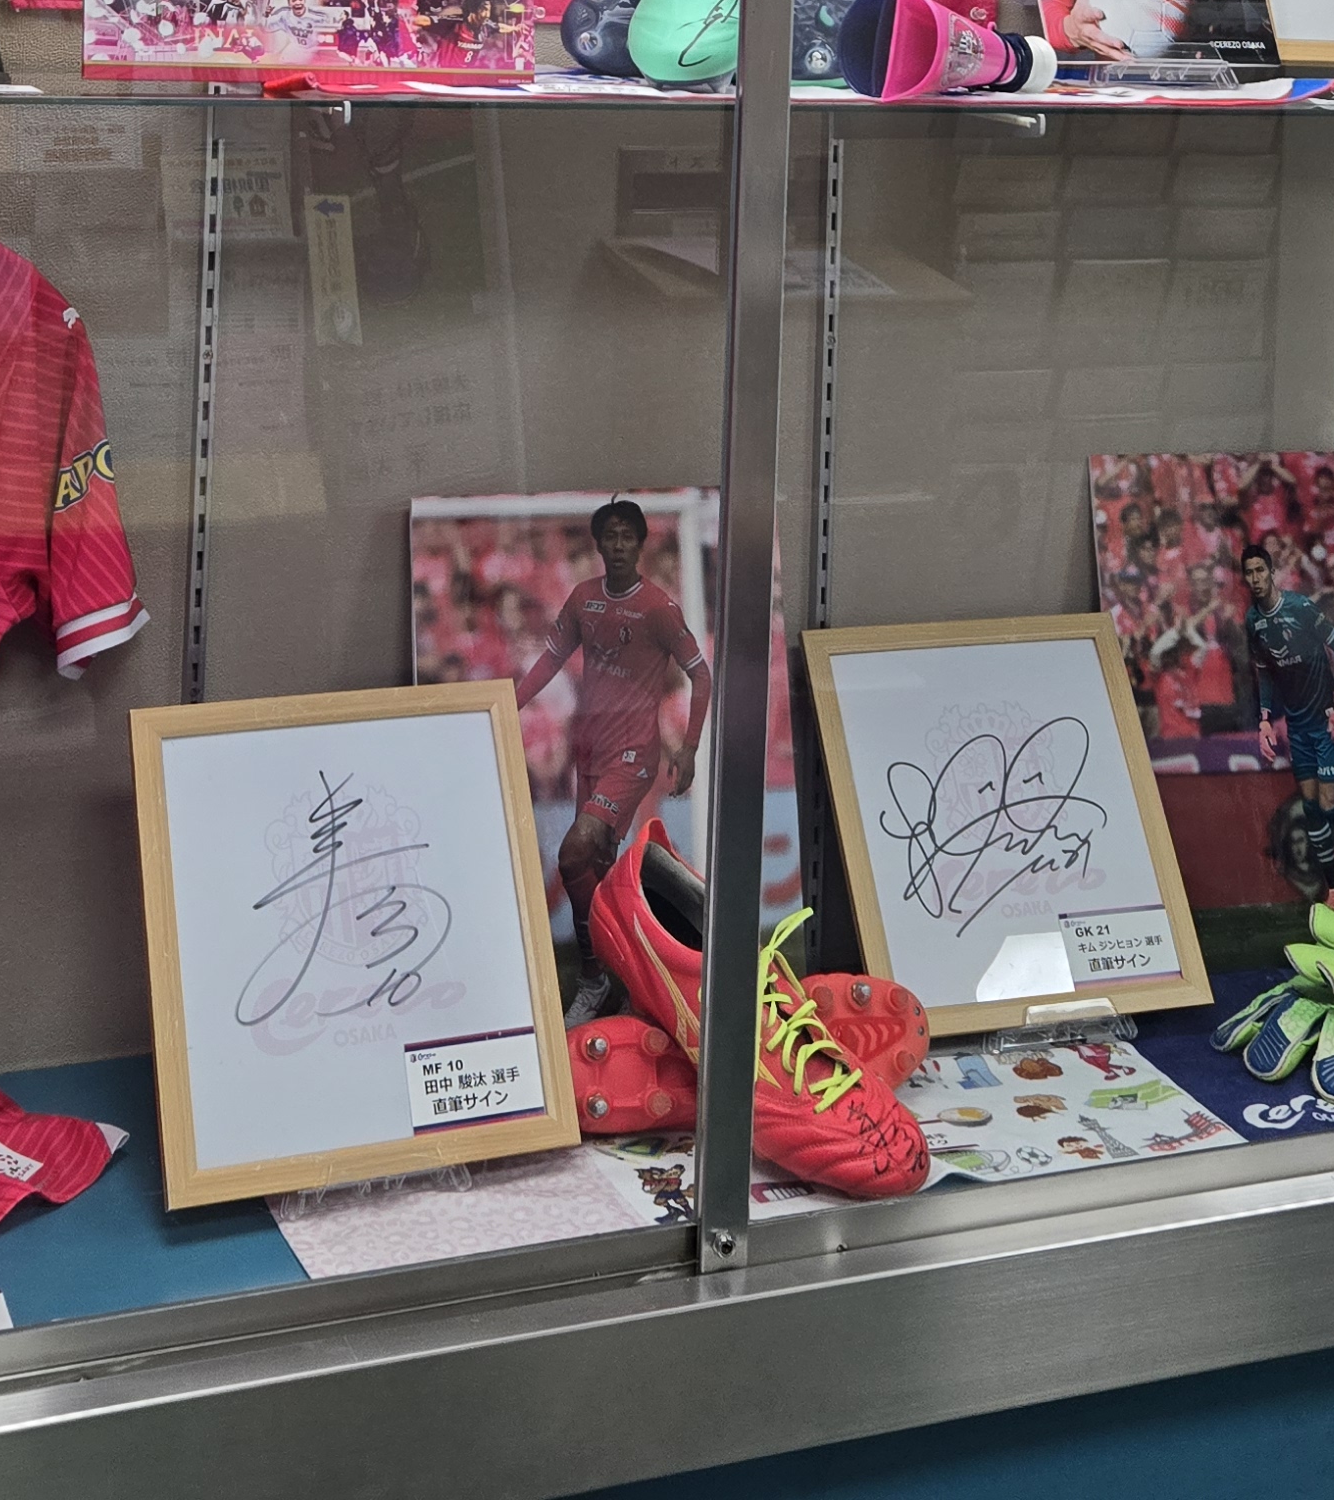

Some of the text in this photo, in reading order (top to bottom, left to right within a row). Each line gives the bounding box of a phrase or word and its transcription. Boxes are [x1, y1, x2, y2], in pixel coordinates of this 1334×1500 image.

[1075, 925, 1111, 938] GK 21
[1078, 934, 1164, 954] キム ジンヒョン 選手
[1088, 953, 1152, 973] 直筆サイン
[367, 968, 423, 1007] 10
[422, 1059, 464, 1077] MF 10
[424, 1076, 454, 1095] 田中
[491, 1066, 520, 1085] 選手
[431, 1089, 509, 1116] 直筆サイン
